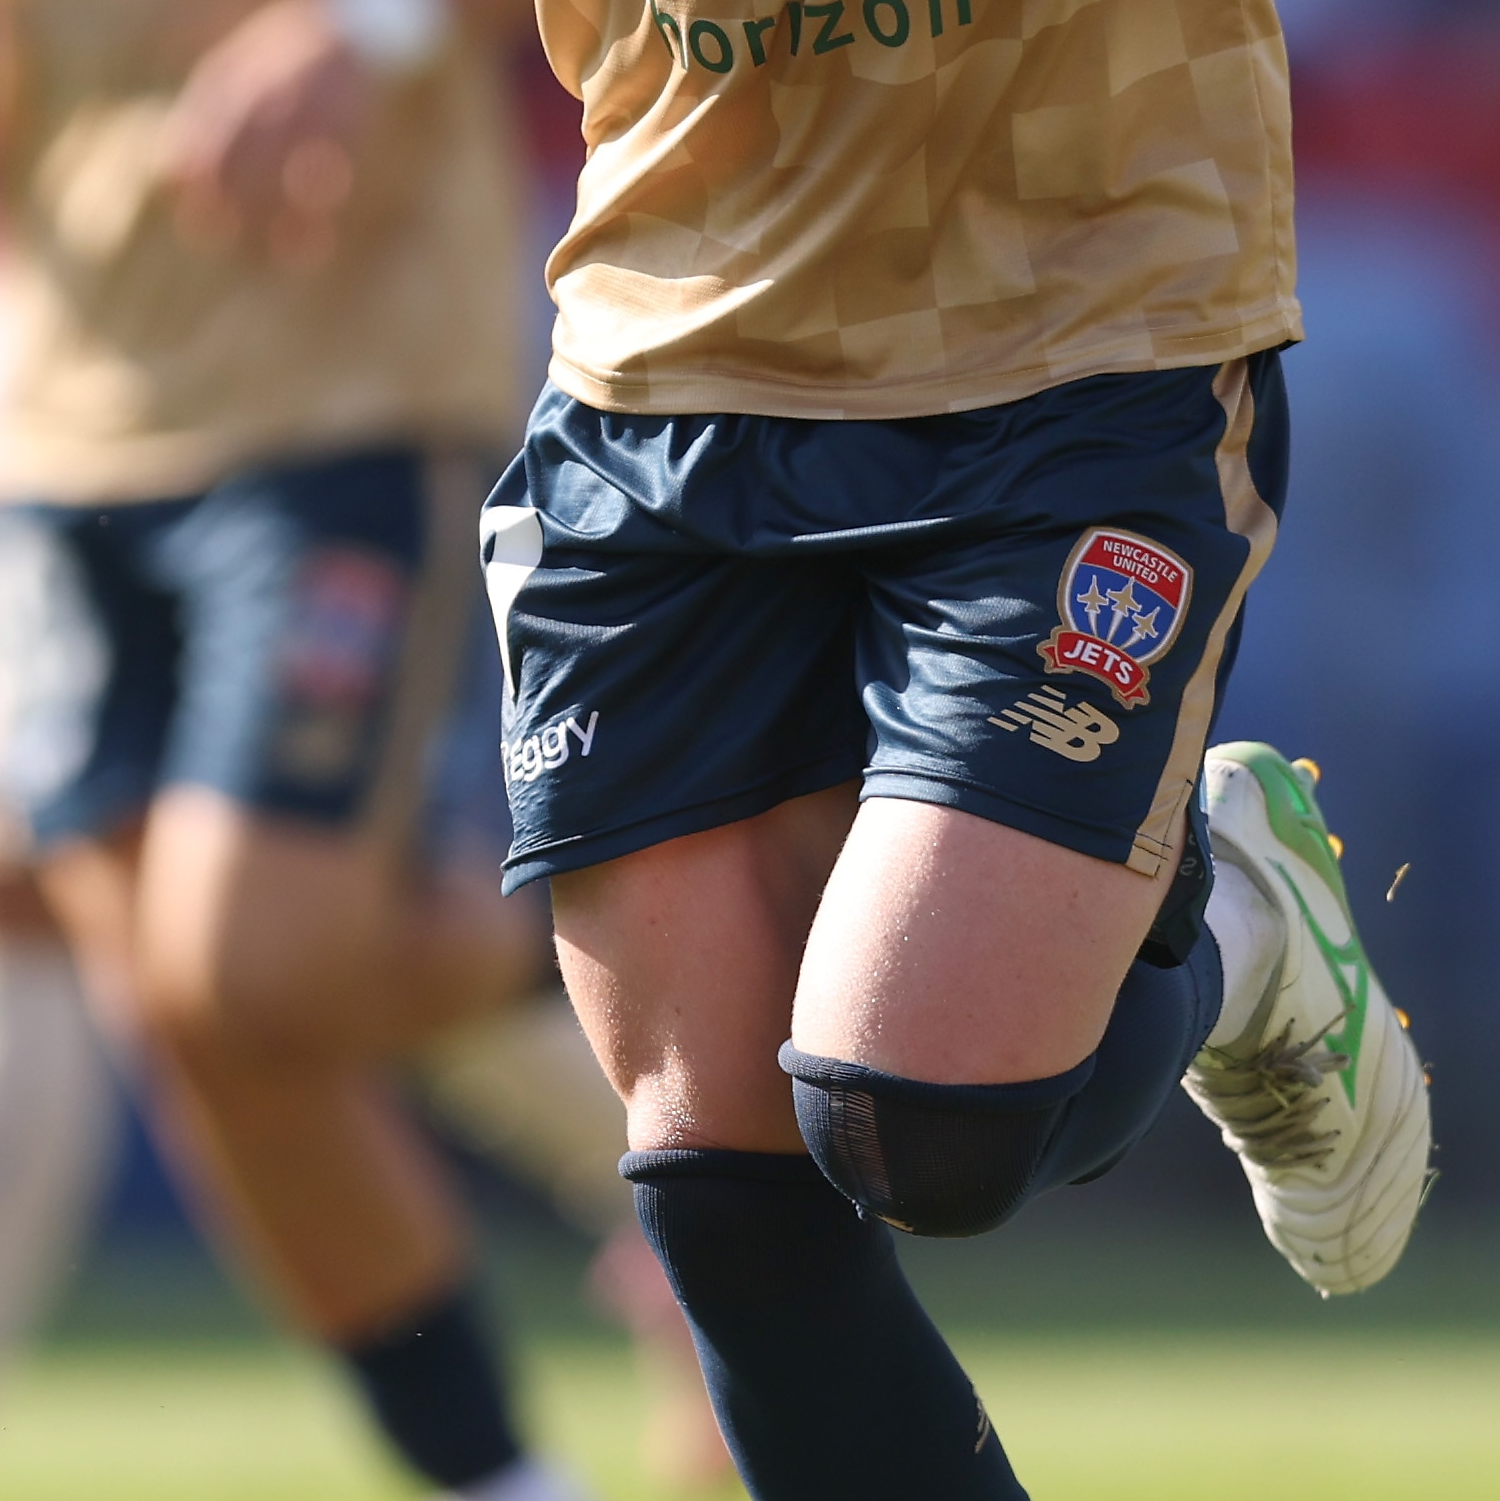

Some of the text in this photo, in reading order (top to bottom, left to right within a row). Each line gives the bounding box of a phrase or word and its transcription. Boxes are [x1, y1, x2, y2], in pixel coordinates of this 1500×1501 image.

[1102, 539, 1179, 584] NEWCASTLE
[1112, 554, 1160, 585] UNITED
[1063, 639, 1134, 685] JETS
